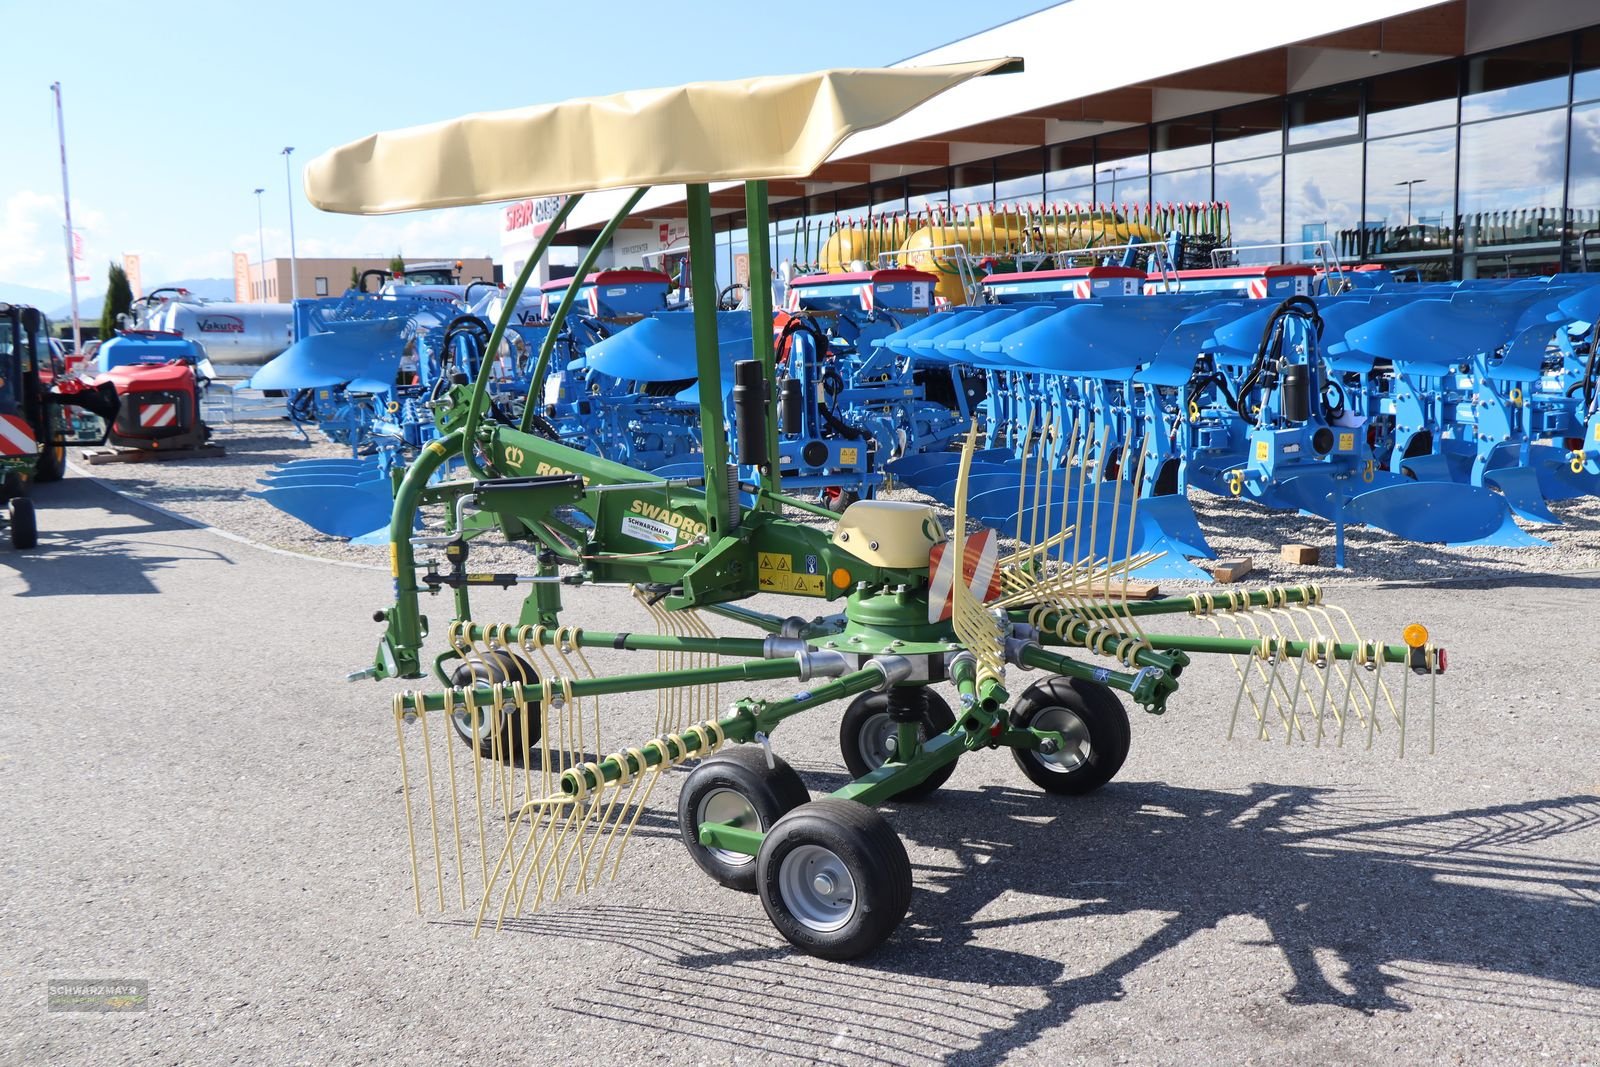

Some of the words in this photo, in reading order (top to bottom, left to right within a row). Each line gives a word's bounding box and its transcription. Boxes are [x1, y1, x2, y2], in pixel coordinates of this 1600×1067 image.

[197, 319, 244, 332] Vakutec
[628, 517, 670, 535] SCHWARZMAYR
[630, 500, 707, 535] SWADRO
